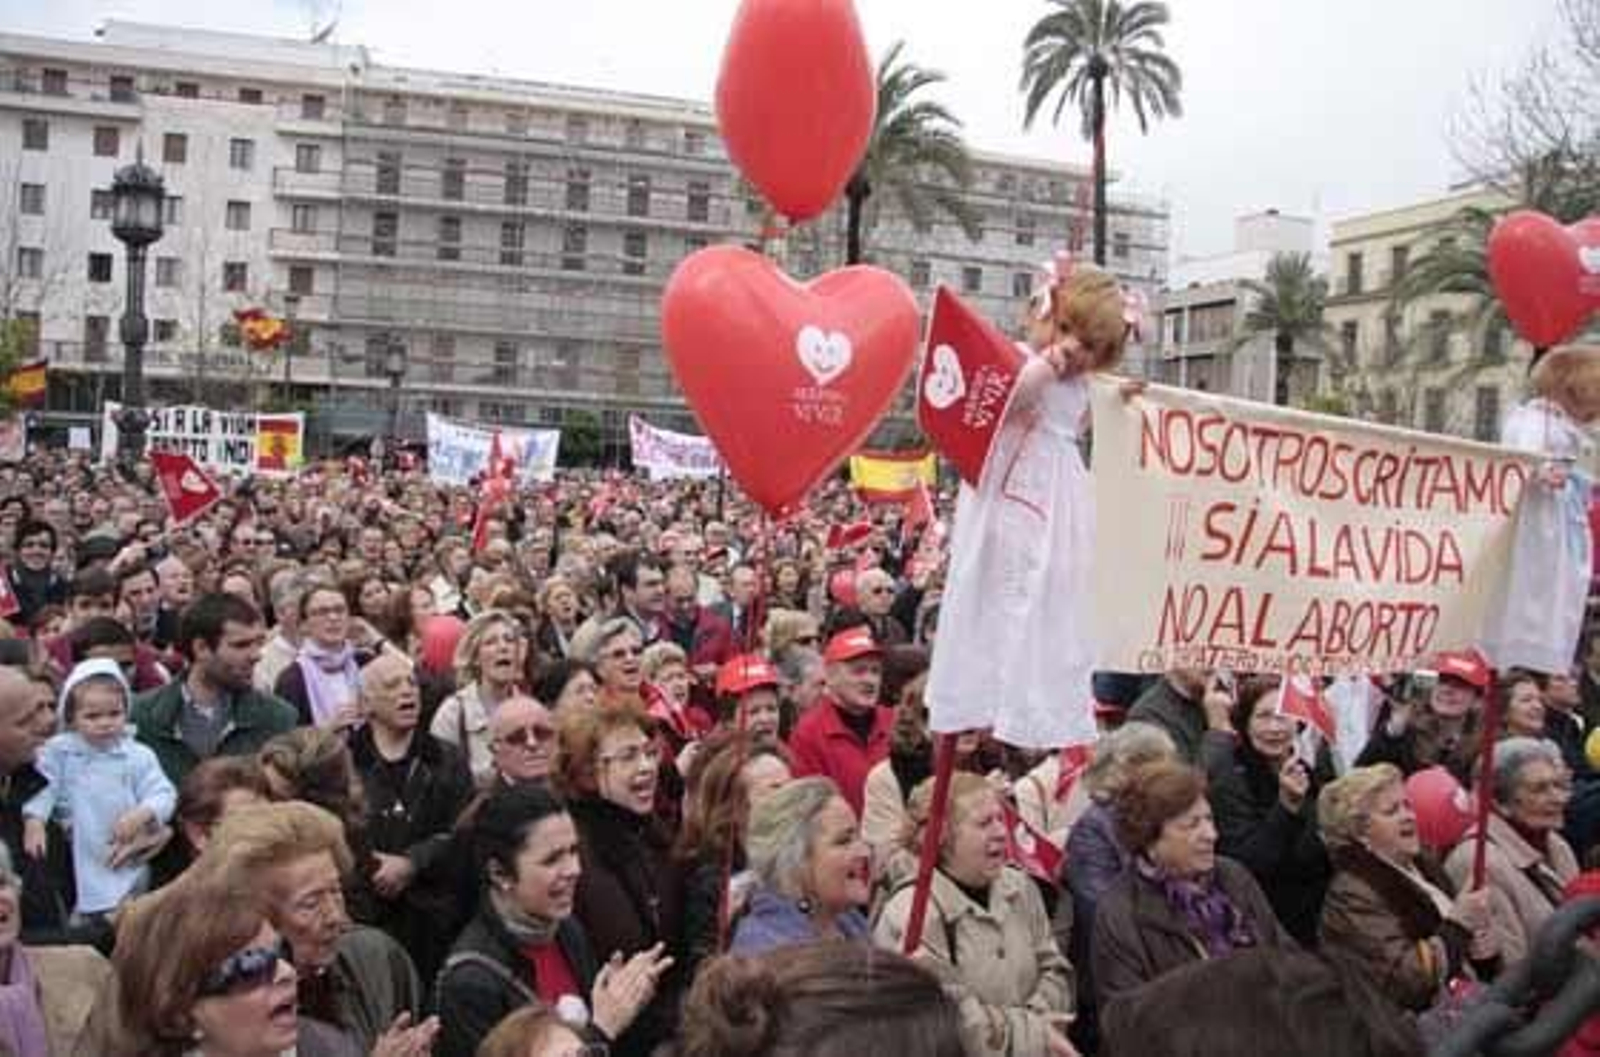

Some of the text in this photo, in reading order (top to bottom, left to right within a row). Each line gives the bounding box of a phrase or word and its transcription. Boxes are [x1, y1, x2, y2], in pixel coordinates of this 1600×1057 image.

[1307, 517, 1361, 582] LA
[1158, 584, 1440, 657] NO AL ABORTO
